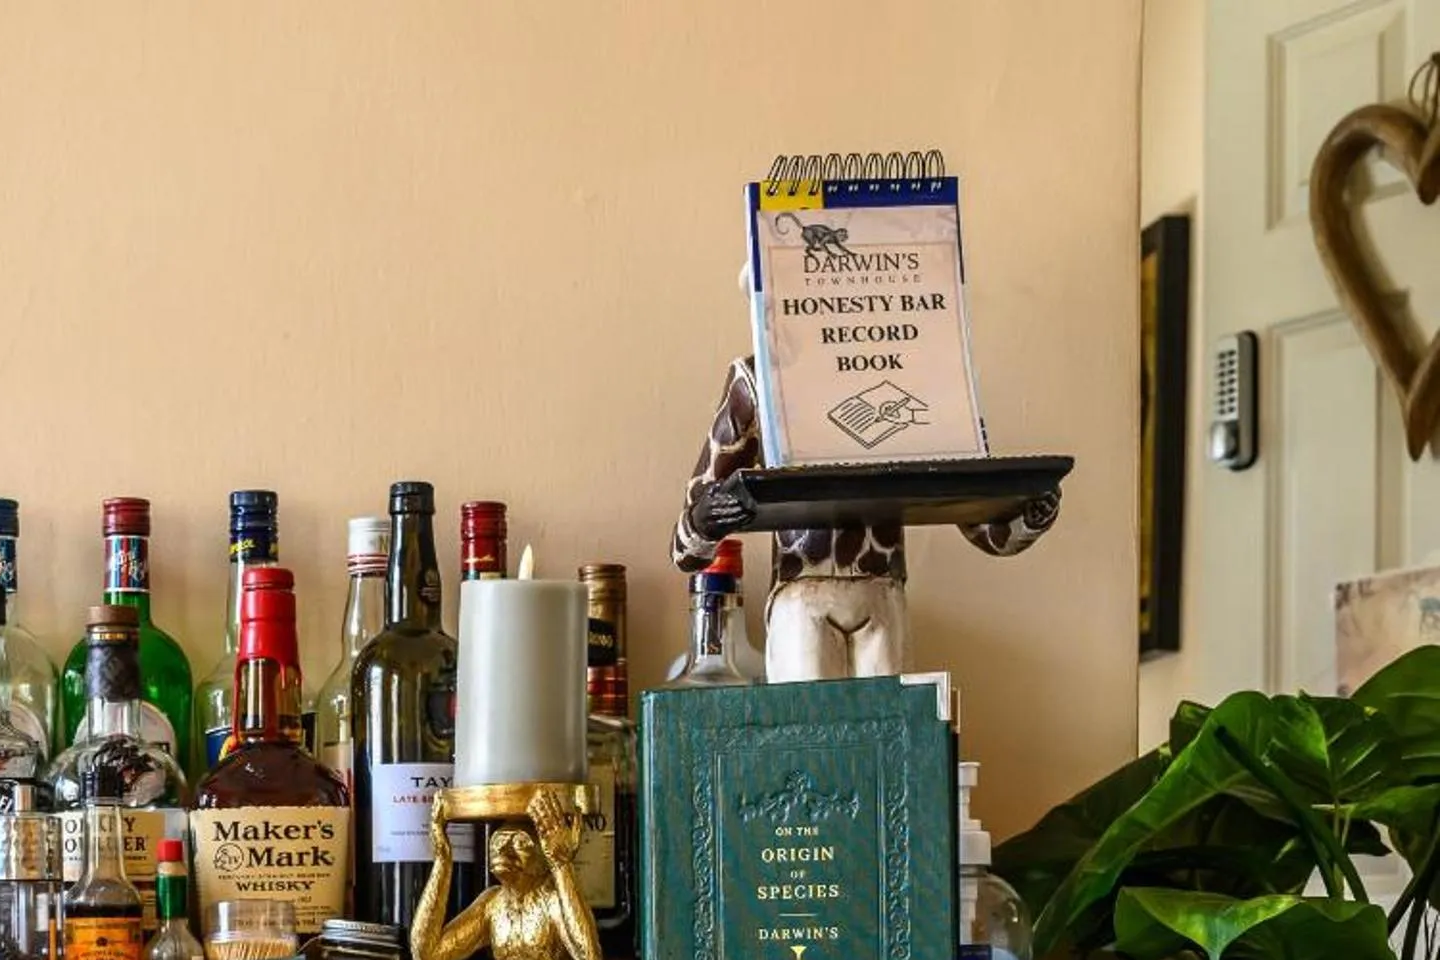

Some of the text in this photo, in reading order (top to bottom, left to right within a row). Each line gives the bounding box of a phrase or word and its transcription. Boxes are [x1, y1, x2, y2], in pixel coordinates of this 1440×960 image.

[803, 252, 918, 274] DARWIN'S
[805, 274, 921, 285] TOWNHOUSE
[783, 293, 947, 316] HONESTY BAR
[821, 324, 919, 344] RECORD
[837, 354, 904, 372] BOOK
[212, 820, 335, 842] Maker's
[775, 825, 819, 836] ON THE
[247, 846, 334, 868] Mark
[761, 846, 834, 863] ORIGIN
[790, 869, 806, 879] OF
[235, 881, 316, 892] WHISKY
[757, 884, 839, 900] SPECIES
[759, 927, 839, 940] DARWIN'S
